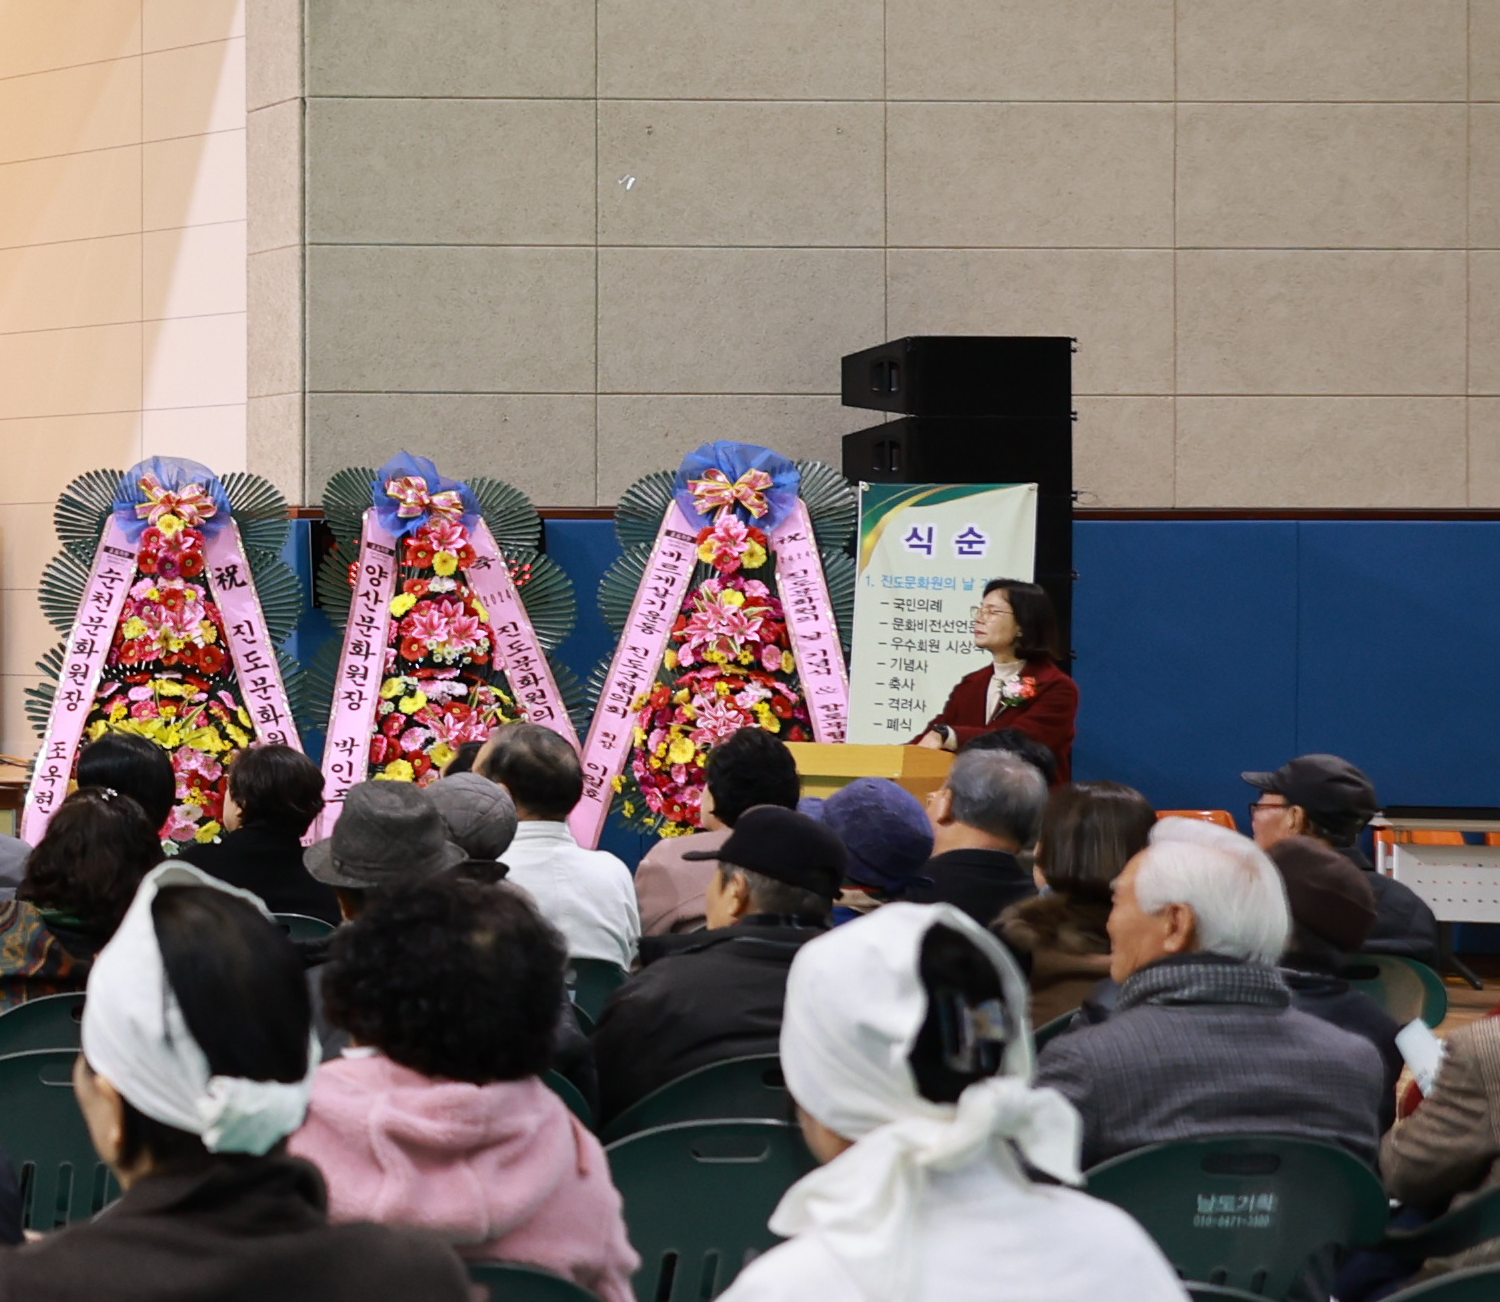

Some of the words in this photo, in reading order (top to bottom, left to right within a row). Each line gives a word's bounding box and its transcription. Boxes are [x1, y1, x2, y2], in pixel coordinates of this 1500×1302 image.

[215, 563, 248, 591] 祝
[880, 575, 957, 590] 진도문화원의
[962, 579, 975, 591] 날
[483, 588, 513, 608] 2024
[892, 598, 943, 613] 국민의례
[60, 567, 124, 712] 순천문화원장
[344, 563, 389, 711] 양산문화원장
[890, 637, 940, 653] 우수회원
[497, 621, 555, 722] 진도문화원의
[890, 658, 929, 673] 기념사
[888, 677, 915, 691] 축사
[887, 698, 927, 713] 격려사
[886, 718, 912, 732] 폐식
